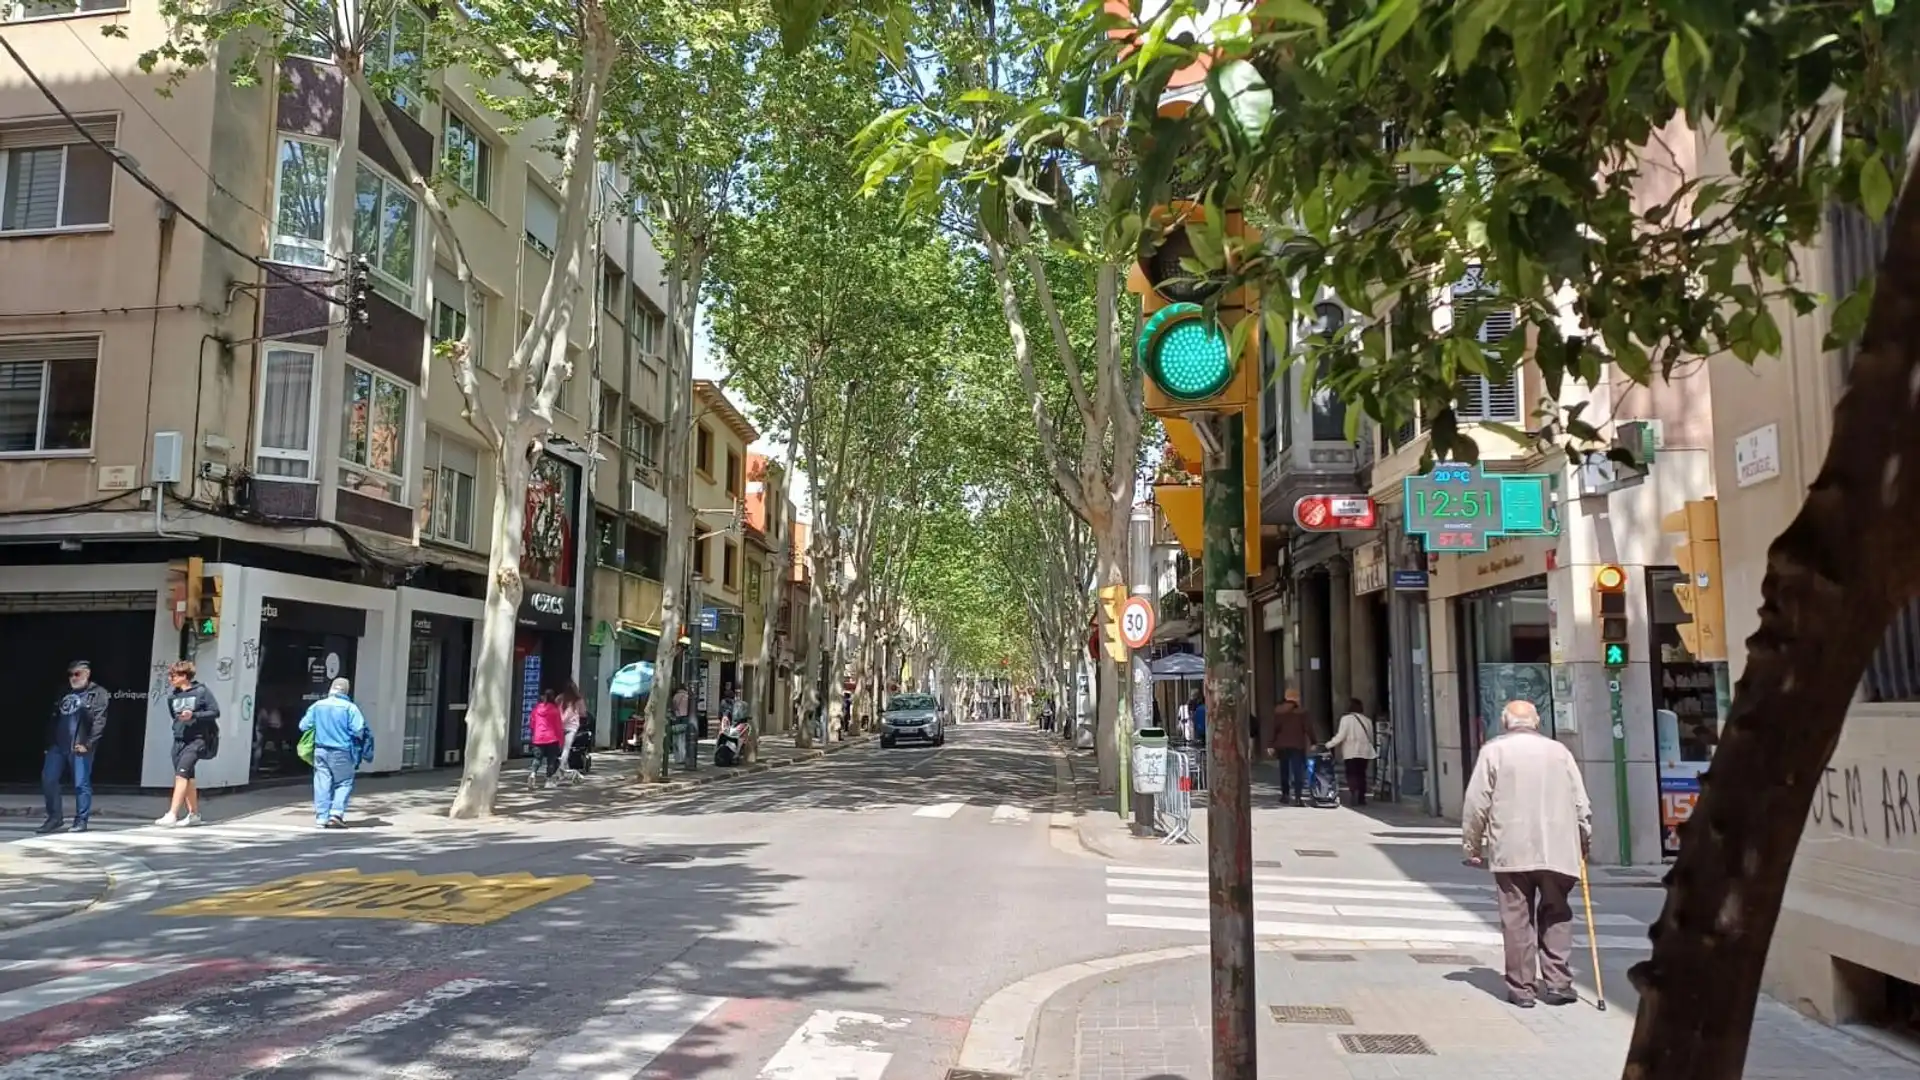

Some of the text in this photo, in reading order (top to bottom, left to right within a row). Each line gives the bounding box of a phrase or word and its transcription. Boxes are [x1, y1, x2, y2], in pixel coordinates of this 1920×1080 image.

[1434, 471, 1451, 482] 20
[1415, 490, 1493, 517] 12:51
[1126, 613, 1144, 632] 30
